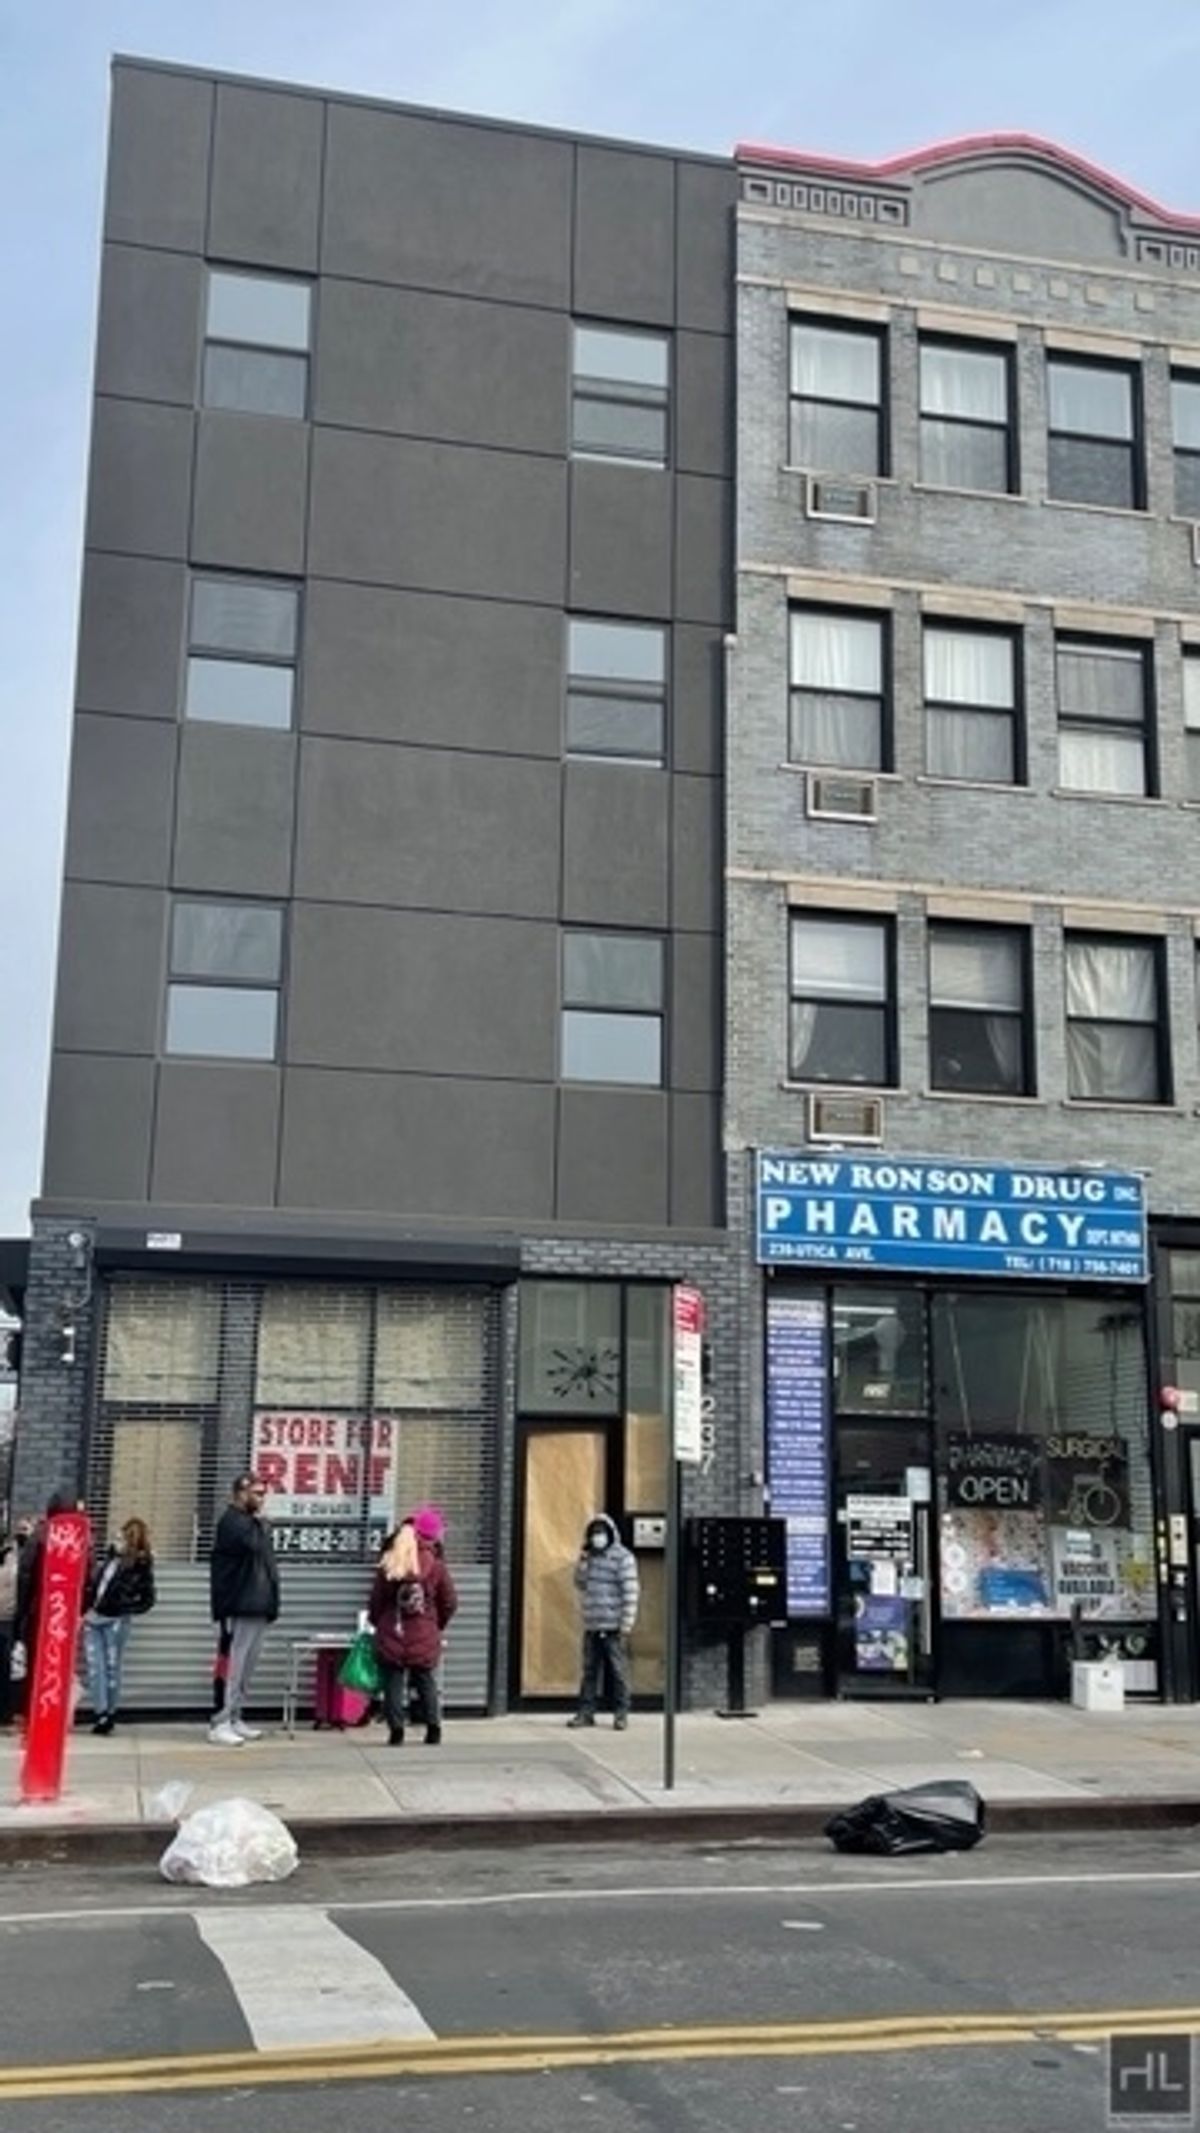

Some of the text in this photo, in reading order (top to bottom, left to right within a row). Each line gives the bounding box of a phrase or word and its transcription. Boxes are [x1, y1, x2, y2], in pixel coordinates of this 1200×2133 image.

[762, 1159, 841, 1186] NEW
[850, 1164, 995, 1197] RONSON
[1010, 1175, 1106, 1201] DRUG
[766, 1197, 1085, 1247] PHARMACY
[260, 1417, 392, 1449] STORE FOR
[256, 1453, 392, 1495] RENT
[959, 1475, 1029, 1503] OPEN
